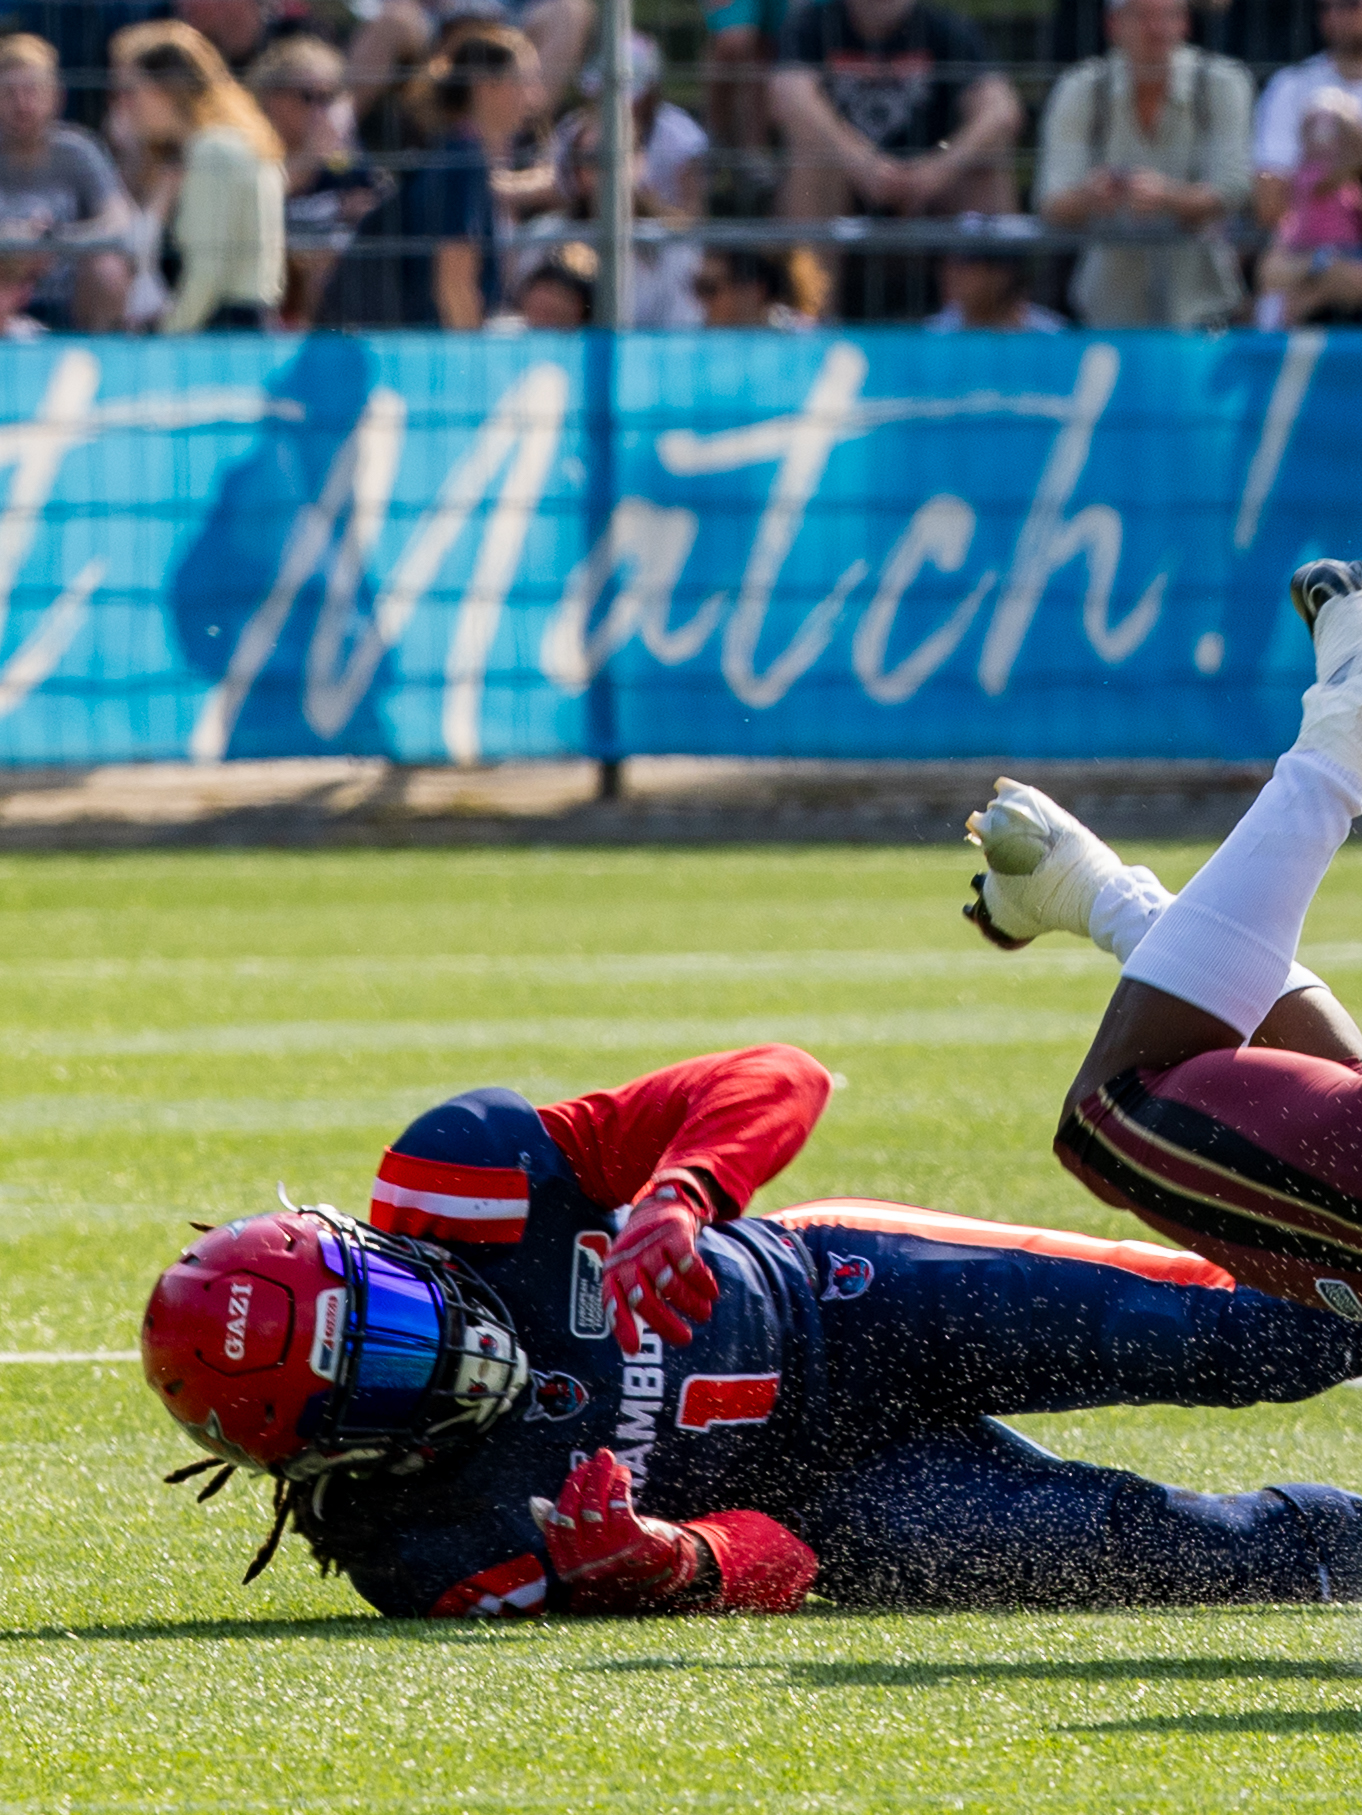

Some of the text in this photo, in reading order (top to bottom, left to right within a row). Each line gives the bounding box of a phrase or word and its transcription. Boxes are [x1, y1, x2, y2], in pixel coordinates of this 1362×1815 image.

[190, 329, 1327, 763] Match!
[224, 1282, 254, 1361] GAZI
[675, 1371, 782, 1433] 1
